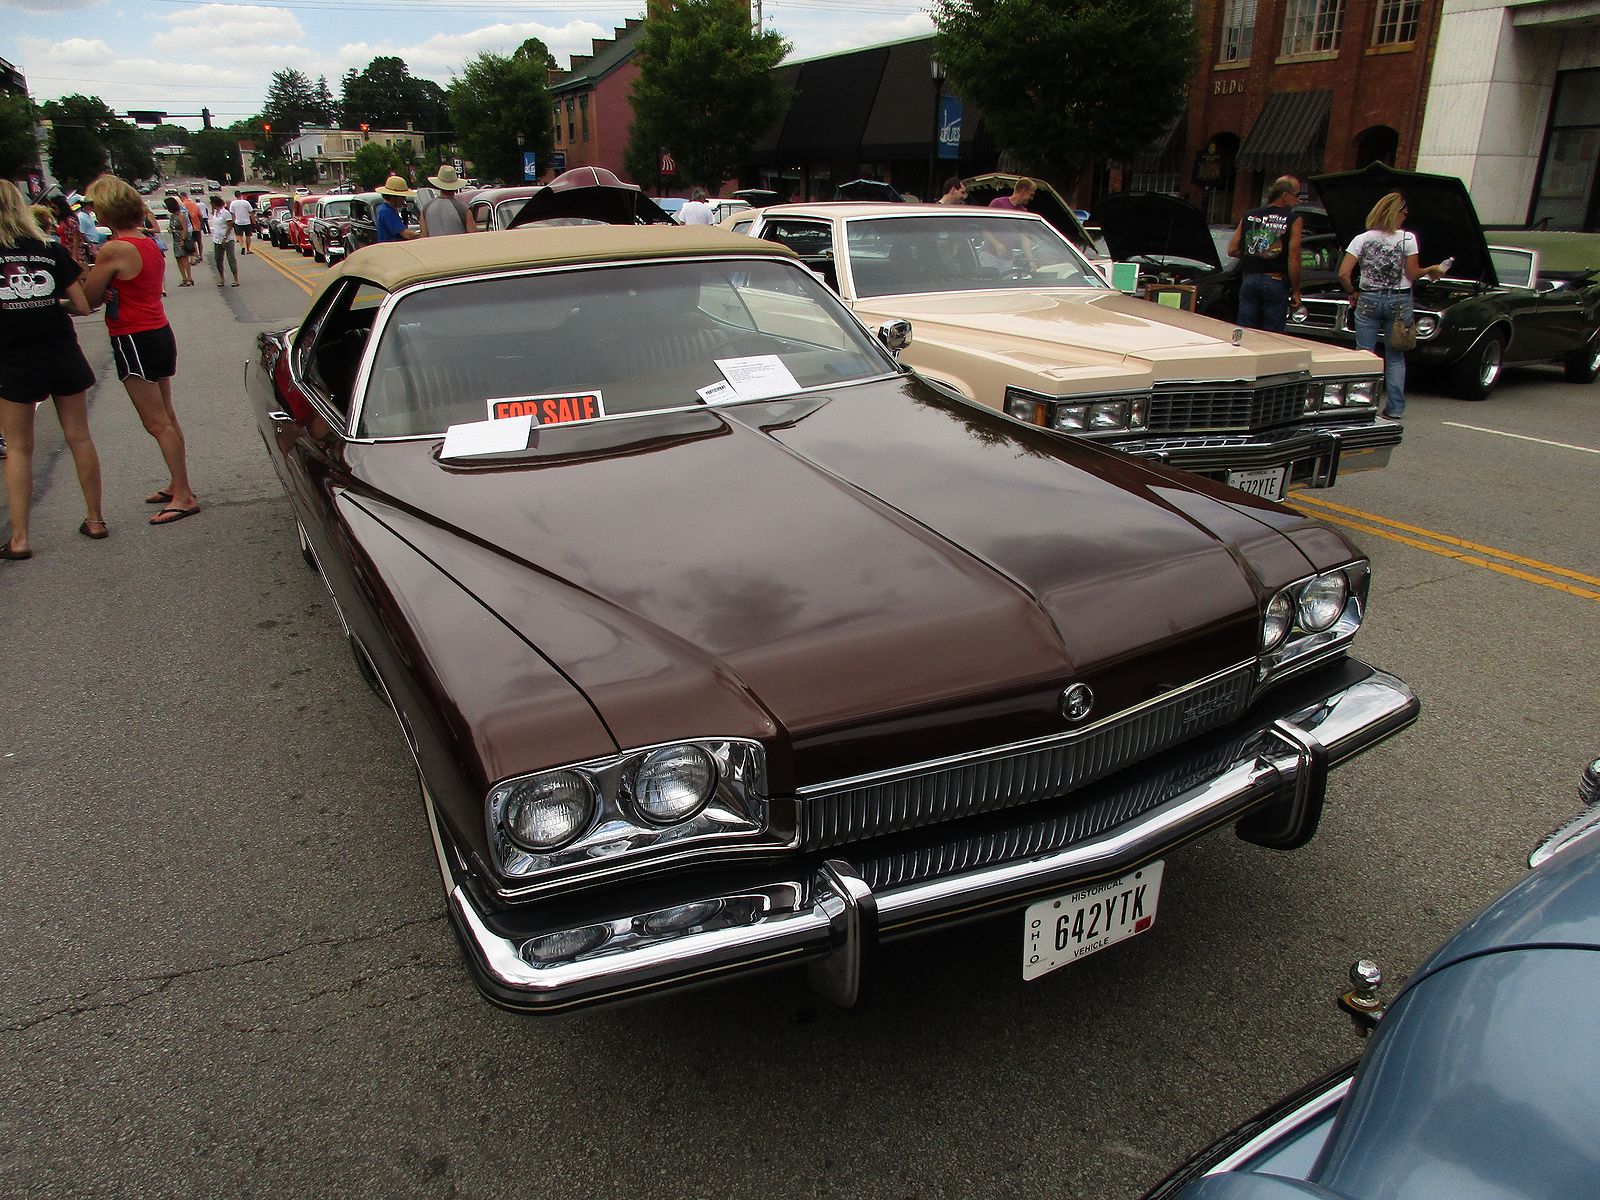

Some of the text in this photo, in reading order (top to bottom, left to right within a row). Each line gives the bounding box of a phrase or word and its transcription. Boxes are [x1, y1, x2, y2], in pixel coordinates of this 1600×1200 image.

[3, 298, 55, 309] AIRBORNE
[497, 397, 593, 424] FOR SALE
[1071, 879, 1124, 903] HISTORICAL
[1055, 884, 1147, 951] 642YTK
[1030, 919, 1042, 964] OHIO
[1074, 937, 1110, 957] VEHICLE
